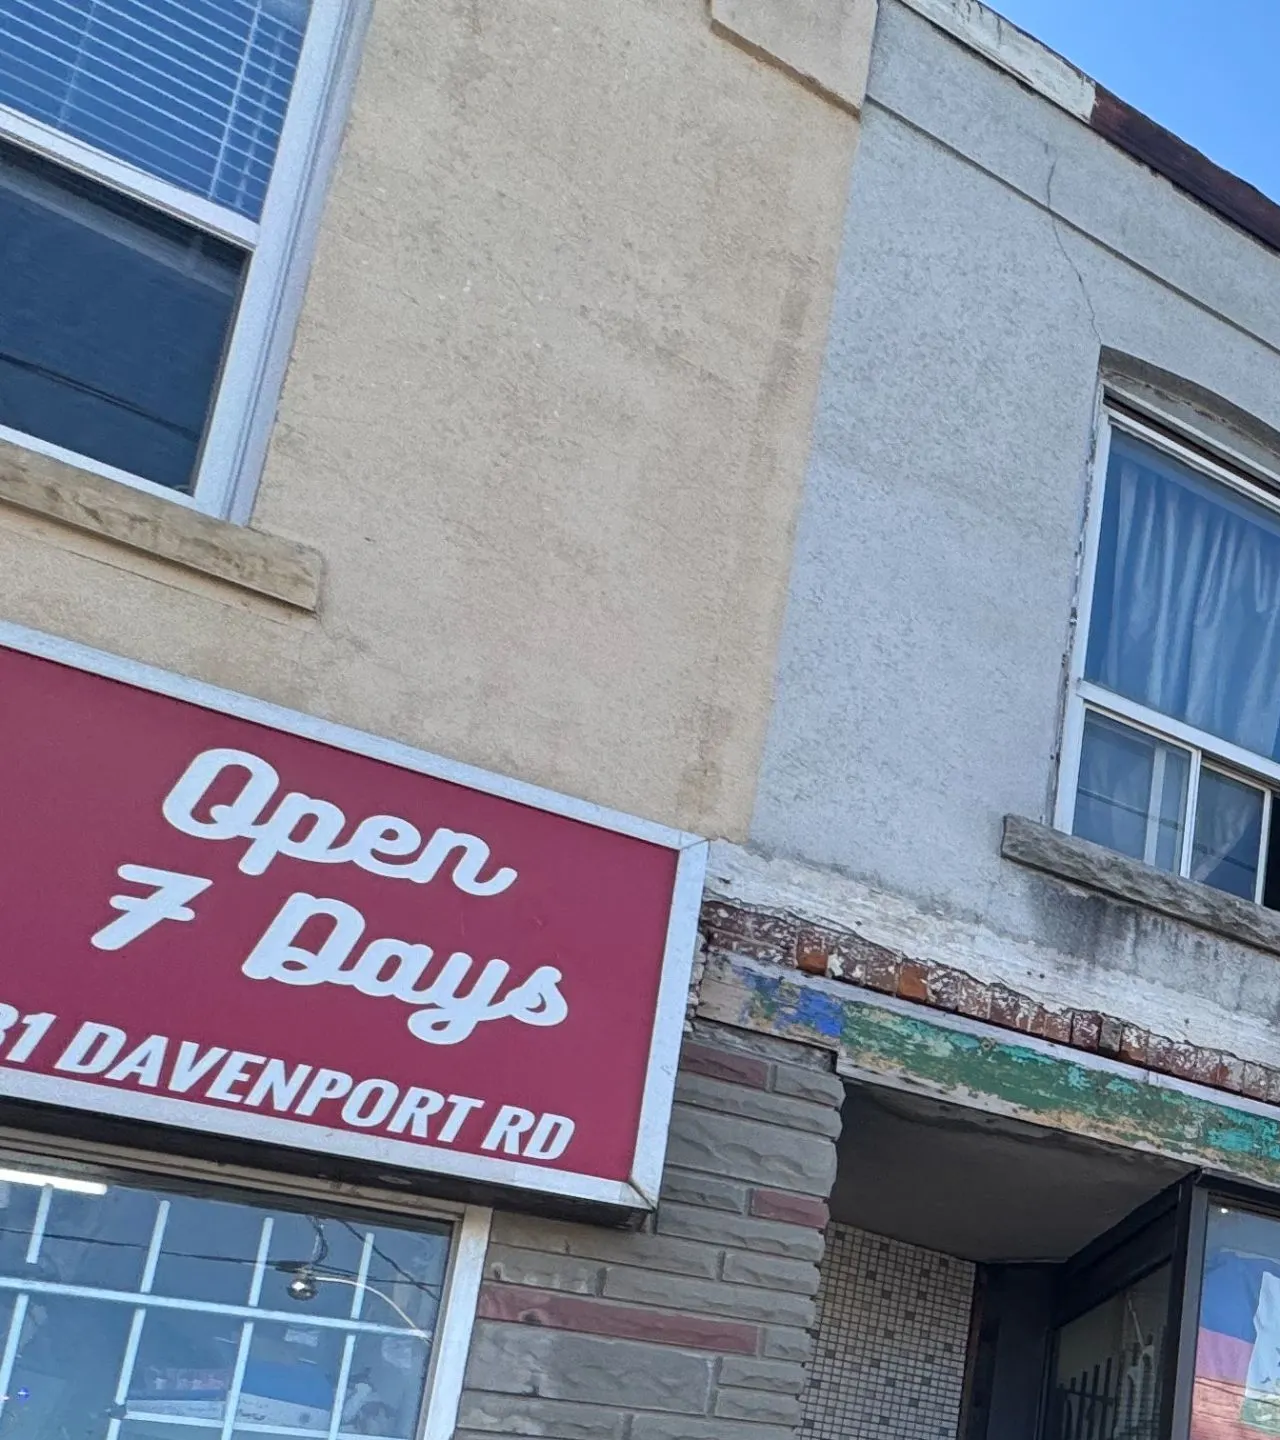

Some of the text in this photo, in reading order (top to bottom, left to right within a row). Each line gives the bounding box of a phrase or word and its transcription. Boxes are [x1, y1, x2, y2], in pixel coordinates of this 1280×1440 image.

[162, 748, 518, 896] Open
[91, 863, 568, 1045] 7 Days
[53, 1020, 484, 1142] DAVENPORT
[481, 1104, 575, 1161] RD
